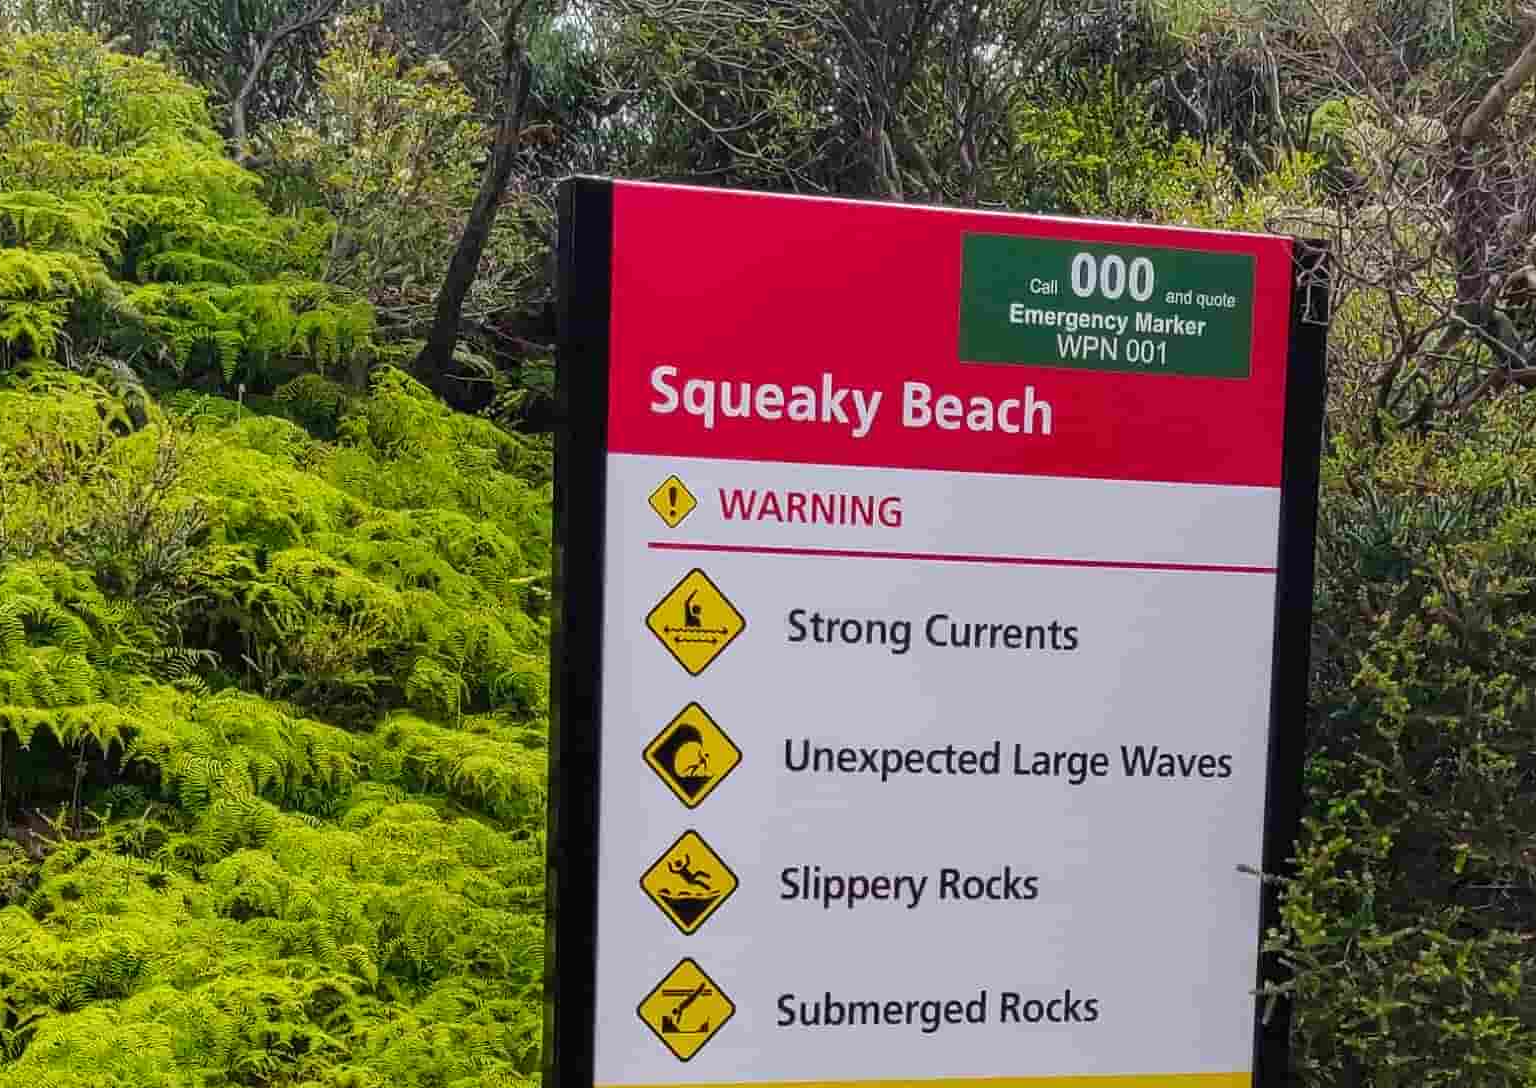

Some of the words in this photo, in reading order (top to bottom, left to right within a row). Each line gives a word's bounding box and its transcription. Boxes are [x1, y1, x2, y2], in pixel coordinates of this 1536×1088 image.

[1030, 278, 1058, 295] Call
[1071, 252, 1155, 301] 000
[1165, 290, 1192, 305] and
[1196, 291, 1236, 309] quote
[1009, 303, 1128, 333] Emergency
[1135, 311, 1207, 336] Marker
[1057, 334, 1118, 361] WPN
[1126, 339, 1166, 364] 001
[650, 366, 882, 438] Squeaky
[902, 382, 1052, 435] Beach
[719, 488, 903, 528] WARNING
[788, 609, 911, 654] Strong
[925, 614, 1079, 651] Currents
[785, 739, 1000, 782] Unexpected
[1014, 743, 1108, 785] Large
[1121, 745, 1232, 778] Waves
[781, 867, 927, 908] Slippery
[939, 868, 1039, 901] Rocks
[777, 990, 987, 1034] Submerged
[1000, 990, 1098, 1024] Rocks
